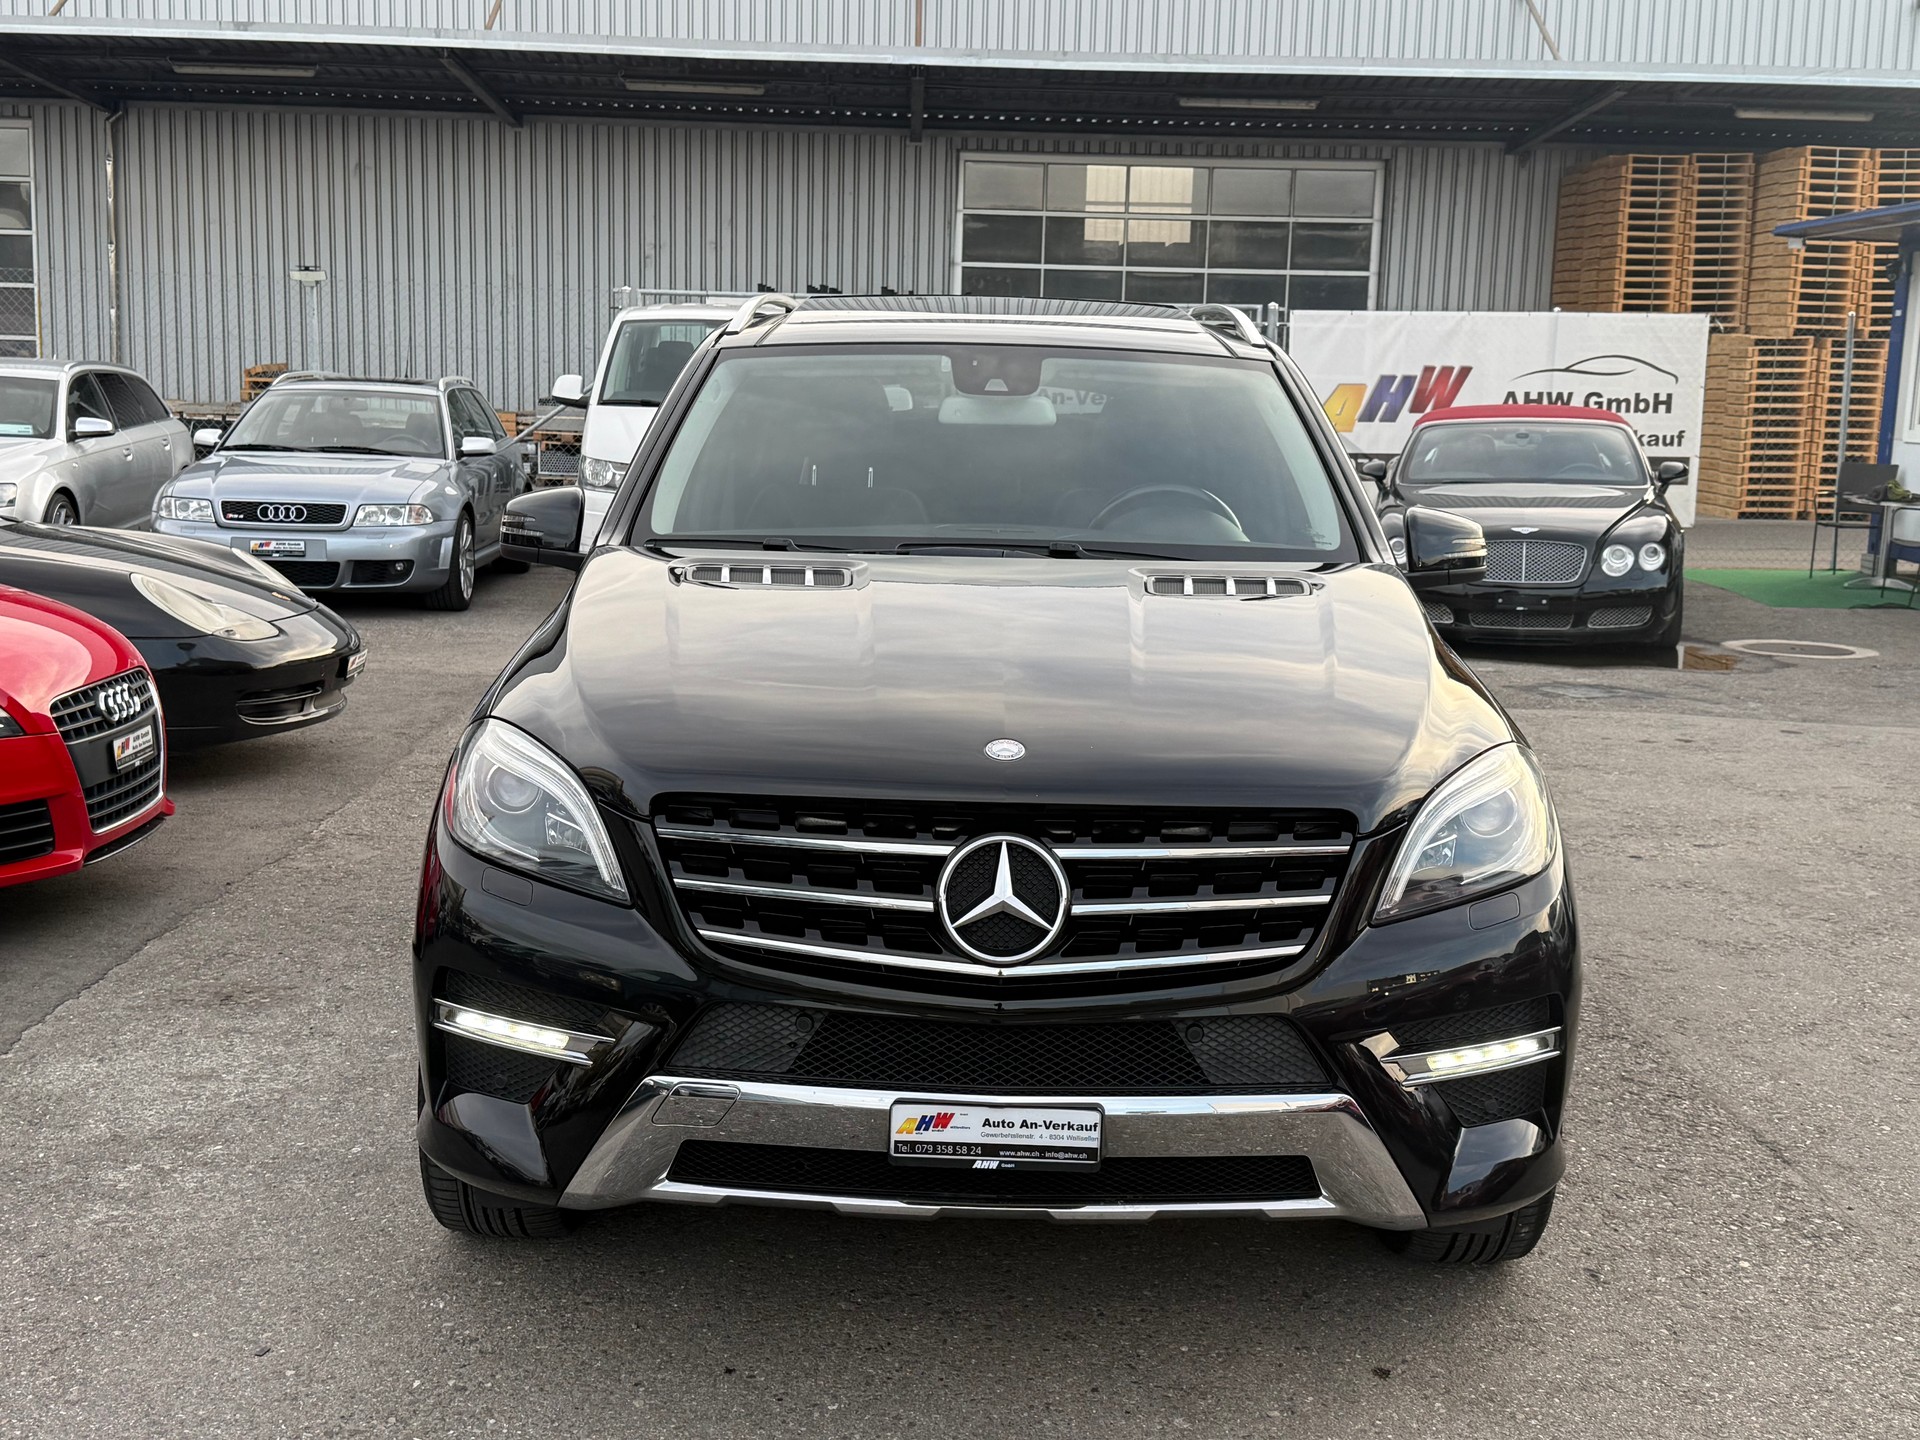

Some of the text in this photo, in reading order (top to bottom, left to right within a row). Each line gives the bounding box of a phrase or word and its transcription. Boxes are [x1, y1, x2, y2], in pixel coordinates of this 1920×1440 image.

[1323, 365, 1473, 432] AHW
[1502, 391, 1673, 414] AHW GmbH
[896, 1112, 956, 1134] AHW
[982, 1118, 1099, 1132] Auto An-Verkauf
[897, 1144, 982, 1154] Tel. 079 358 58 24
[999, 1150, 1040, 1158] www.ahw.ch
[1045, 1151, 1088, 1159] info@ahw.ch
[972, 1160, 999, 1169] AHW
